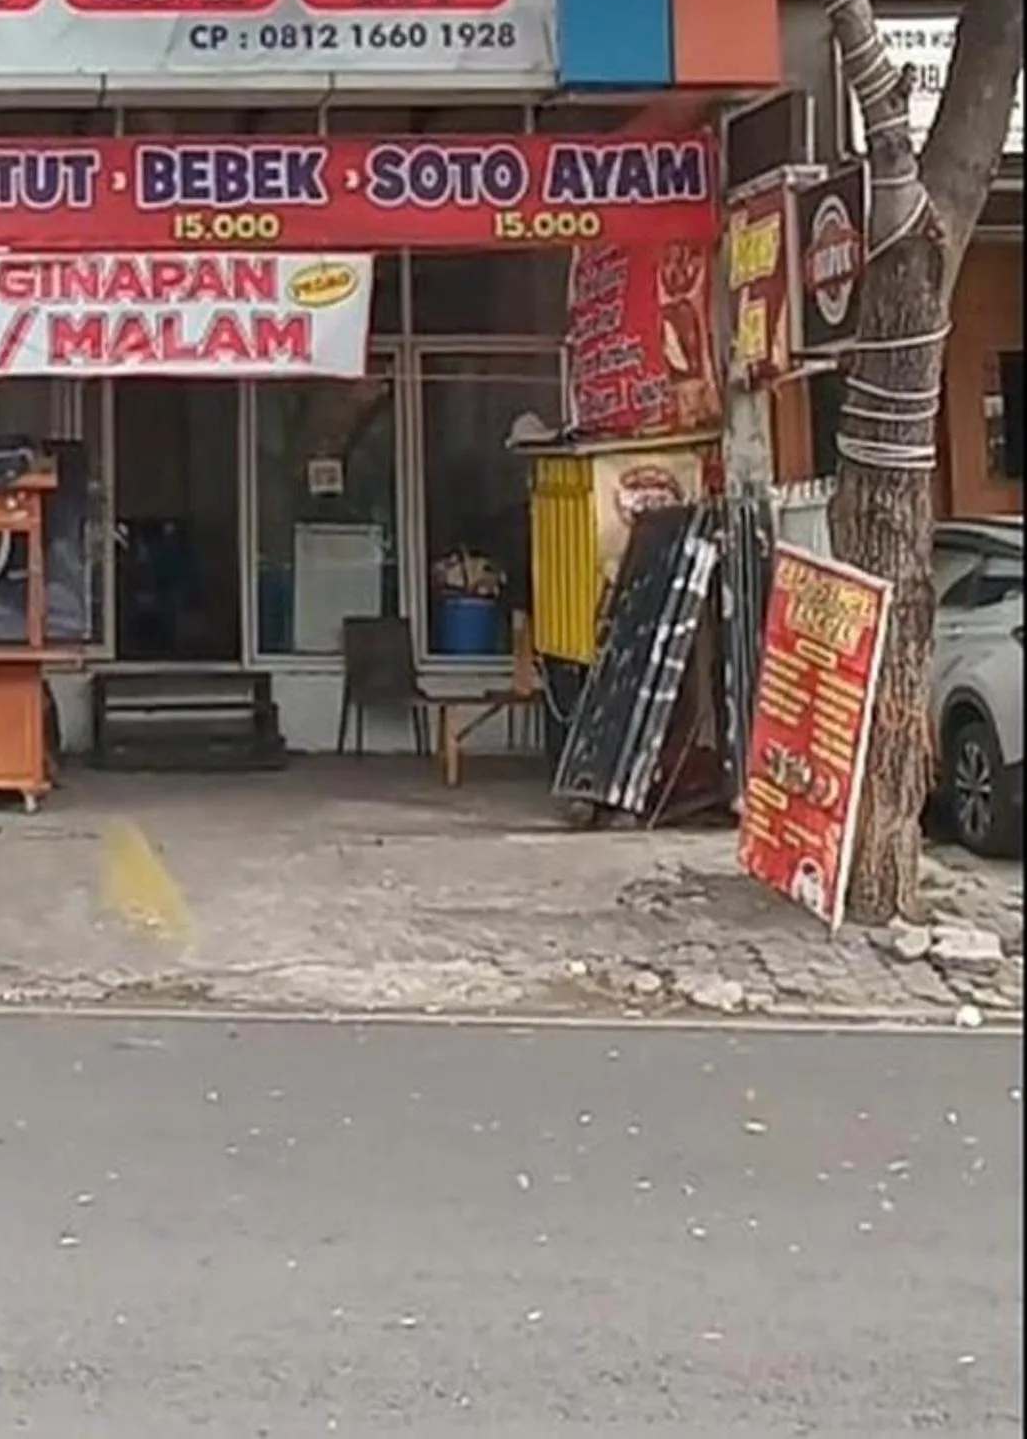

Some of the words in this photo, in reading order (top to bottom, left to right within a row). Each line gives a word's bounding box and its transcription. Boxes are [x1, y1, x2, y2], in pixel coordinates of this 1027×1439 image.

[190, 24, 228, 50] CP
[258, 24, 339, 49] 0812
[349, 23, 431, 48] 1660
[439, 22, 516, 48] 1928
[137, 146, 326, 207] BEBEK
[368, 146, 526, 206] SOTO
[548, 145, 706, 201] AYAM
[173, 213, 280, 240] 15.000
[494, 212, 601, 239] 15.000
[50, 311, 312, 362] MALAM
